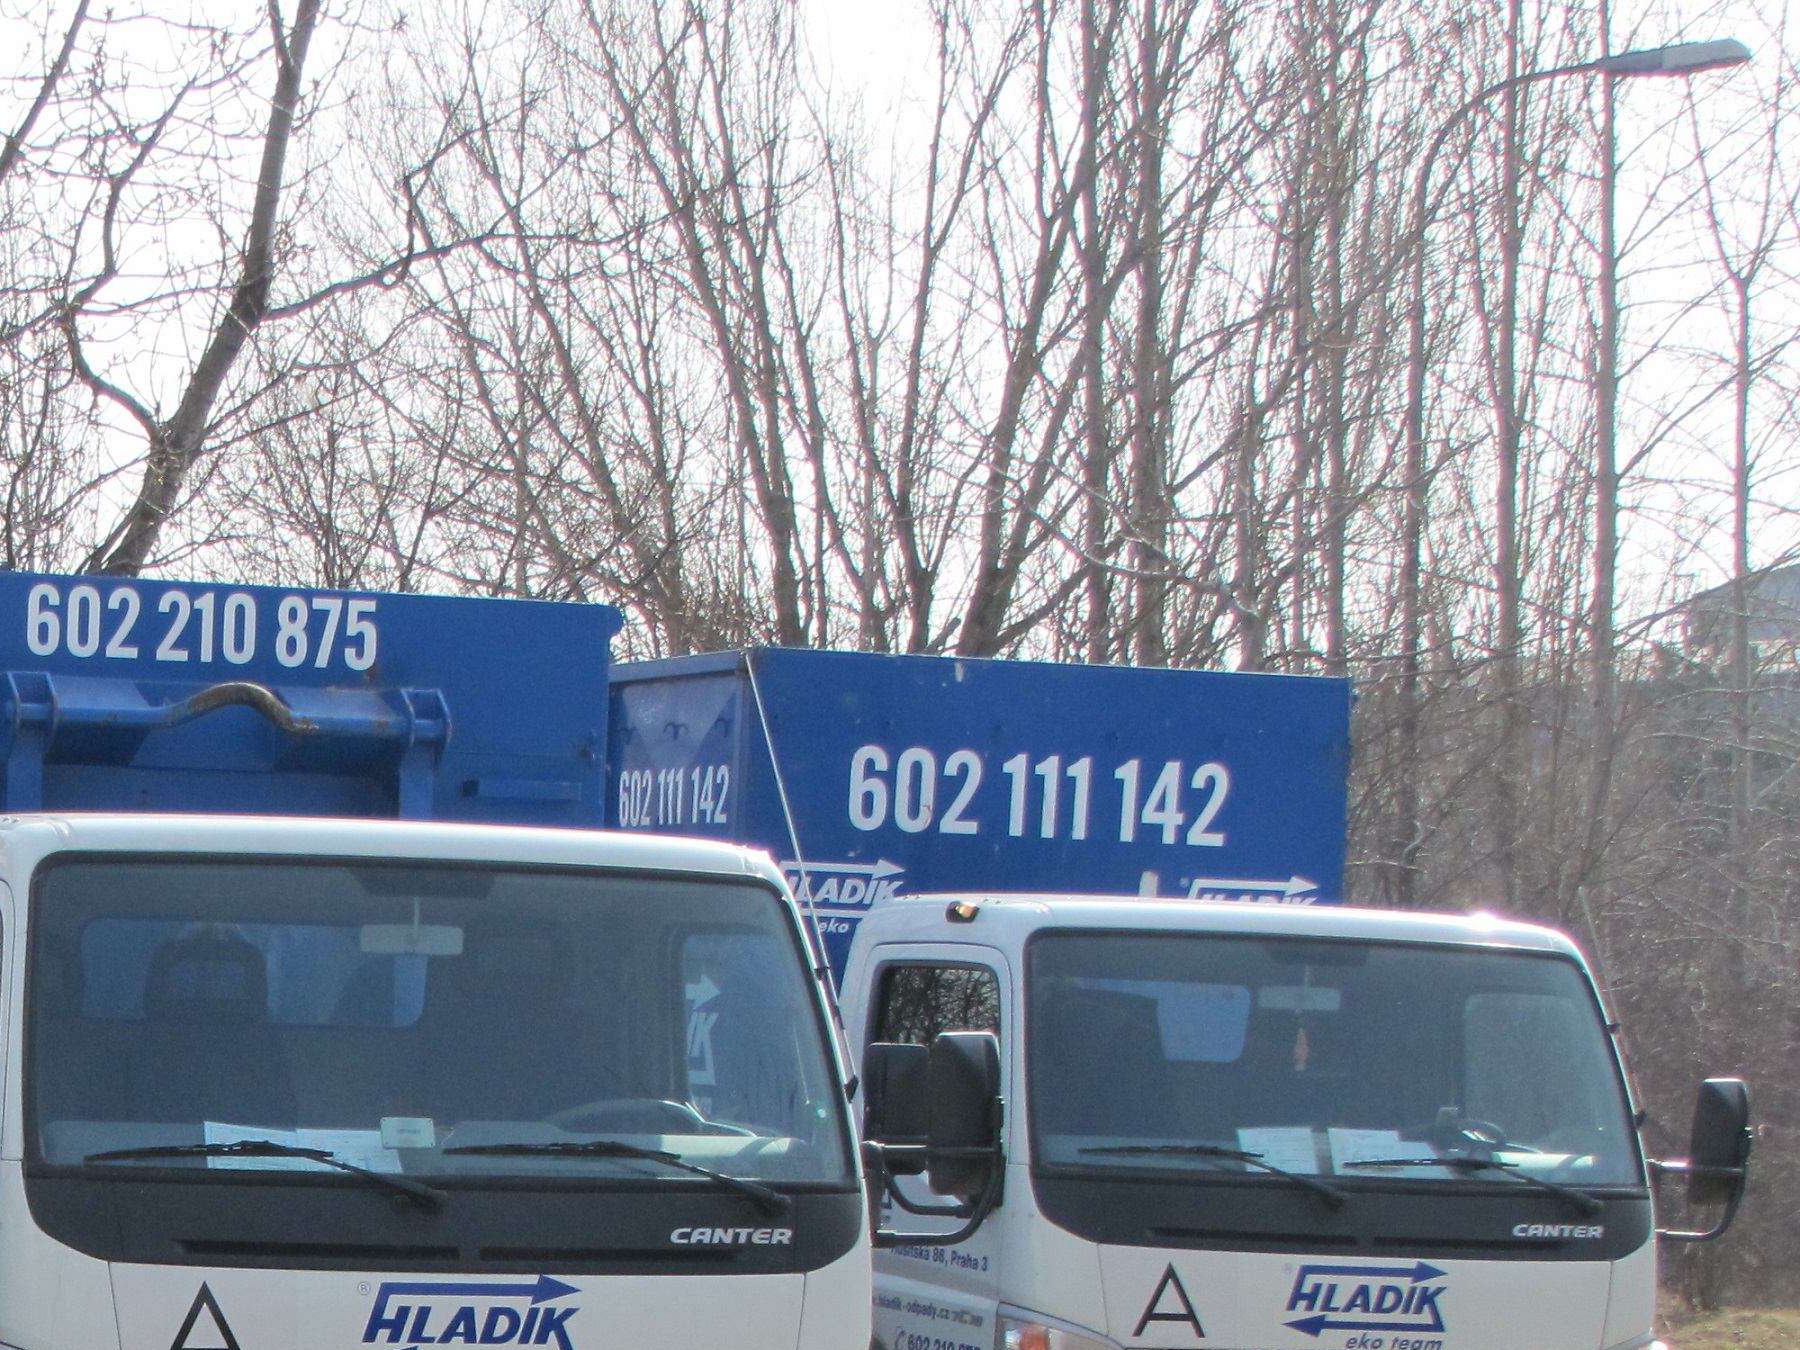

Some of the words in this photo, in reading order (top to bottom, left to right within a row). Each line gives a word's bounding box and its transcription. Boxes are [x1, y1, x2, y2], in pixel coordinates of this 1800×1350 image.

[26, 583, 141, 659] 602
[155, 590, 257, 665] 210
[275, 596, 378, 671] 875
[618, 770, 651, 828] 602
[657, 768, 684, 825] 111
[691, 764, 730, 824] 142
[848, 744, 984, 834] 602
[1002, 753, 1092, 841] 111
[1114, 758, 1230, 847] 142
[669, 1227, 793, 1246] CANTER
[1512, 1223, 1604, 1240] CANTER
[950, 1250, 978, 1270] Praha
[981, 1256, 988, 1272] 3
[1133, 1262, 1206, 1339] A
[1345, 1332, 1383, 1350] eko
[1391, 1336, 1443, 1350] team
